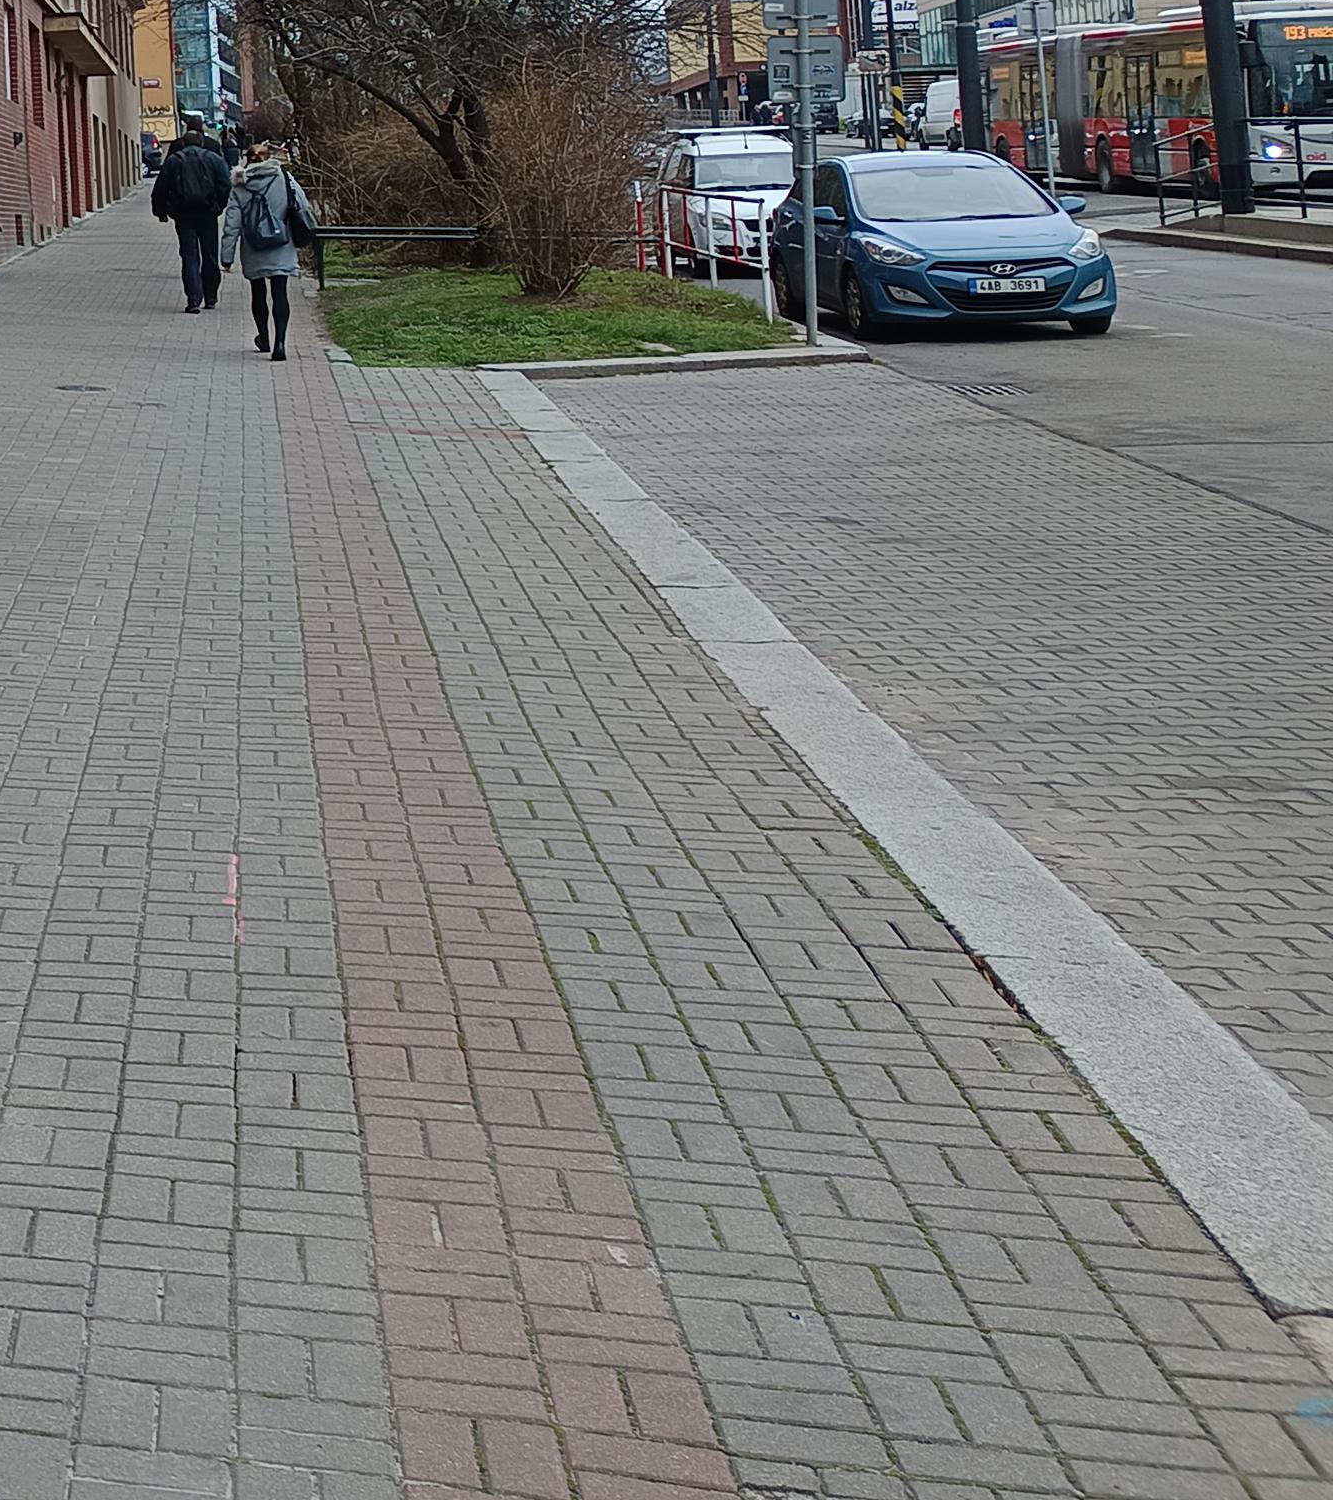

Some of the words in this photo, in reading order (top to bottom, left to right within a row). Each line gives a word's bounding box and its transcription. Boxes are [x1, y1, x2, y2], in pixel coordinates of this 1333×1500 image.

[894, 1, 917, 11] alz
[1283, 26, 1307, 40] 193
[980, 281, 1001, 291] 4AB
[1010, 280, 1039, 290] 3691
